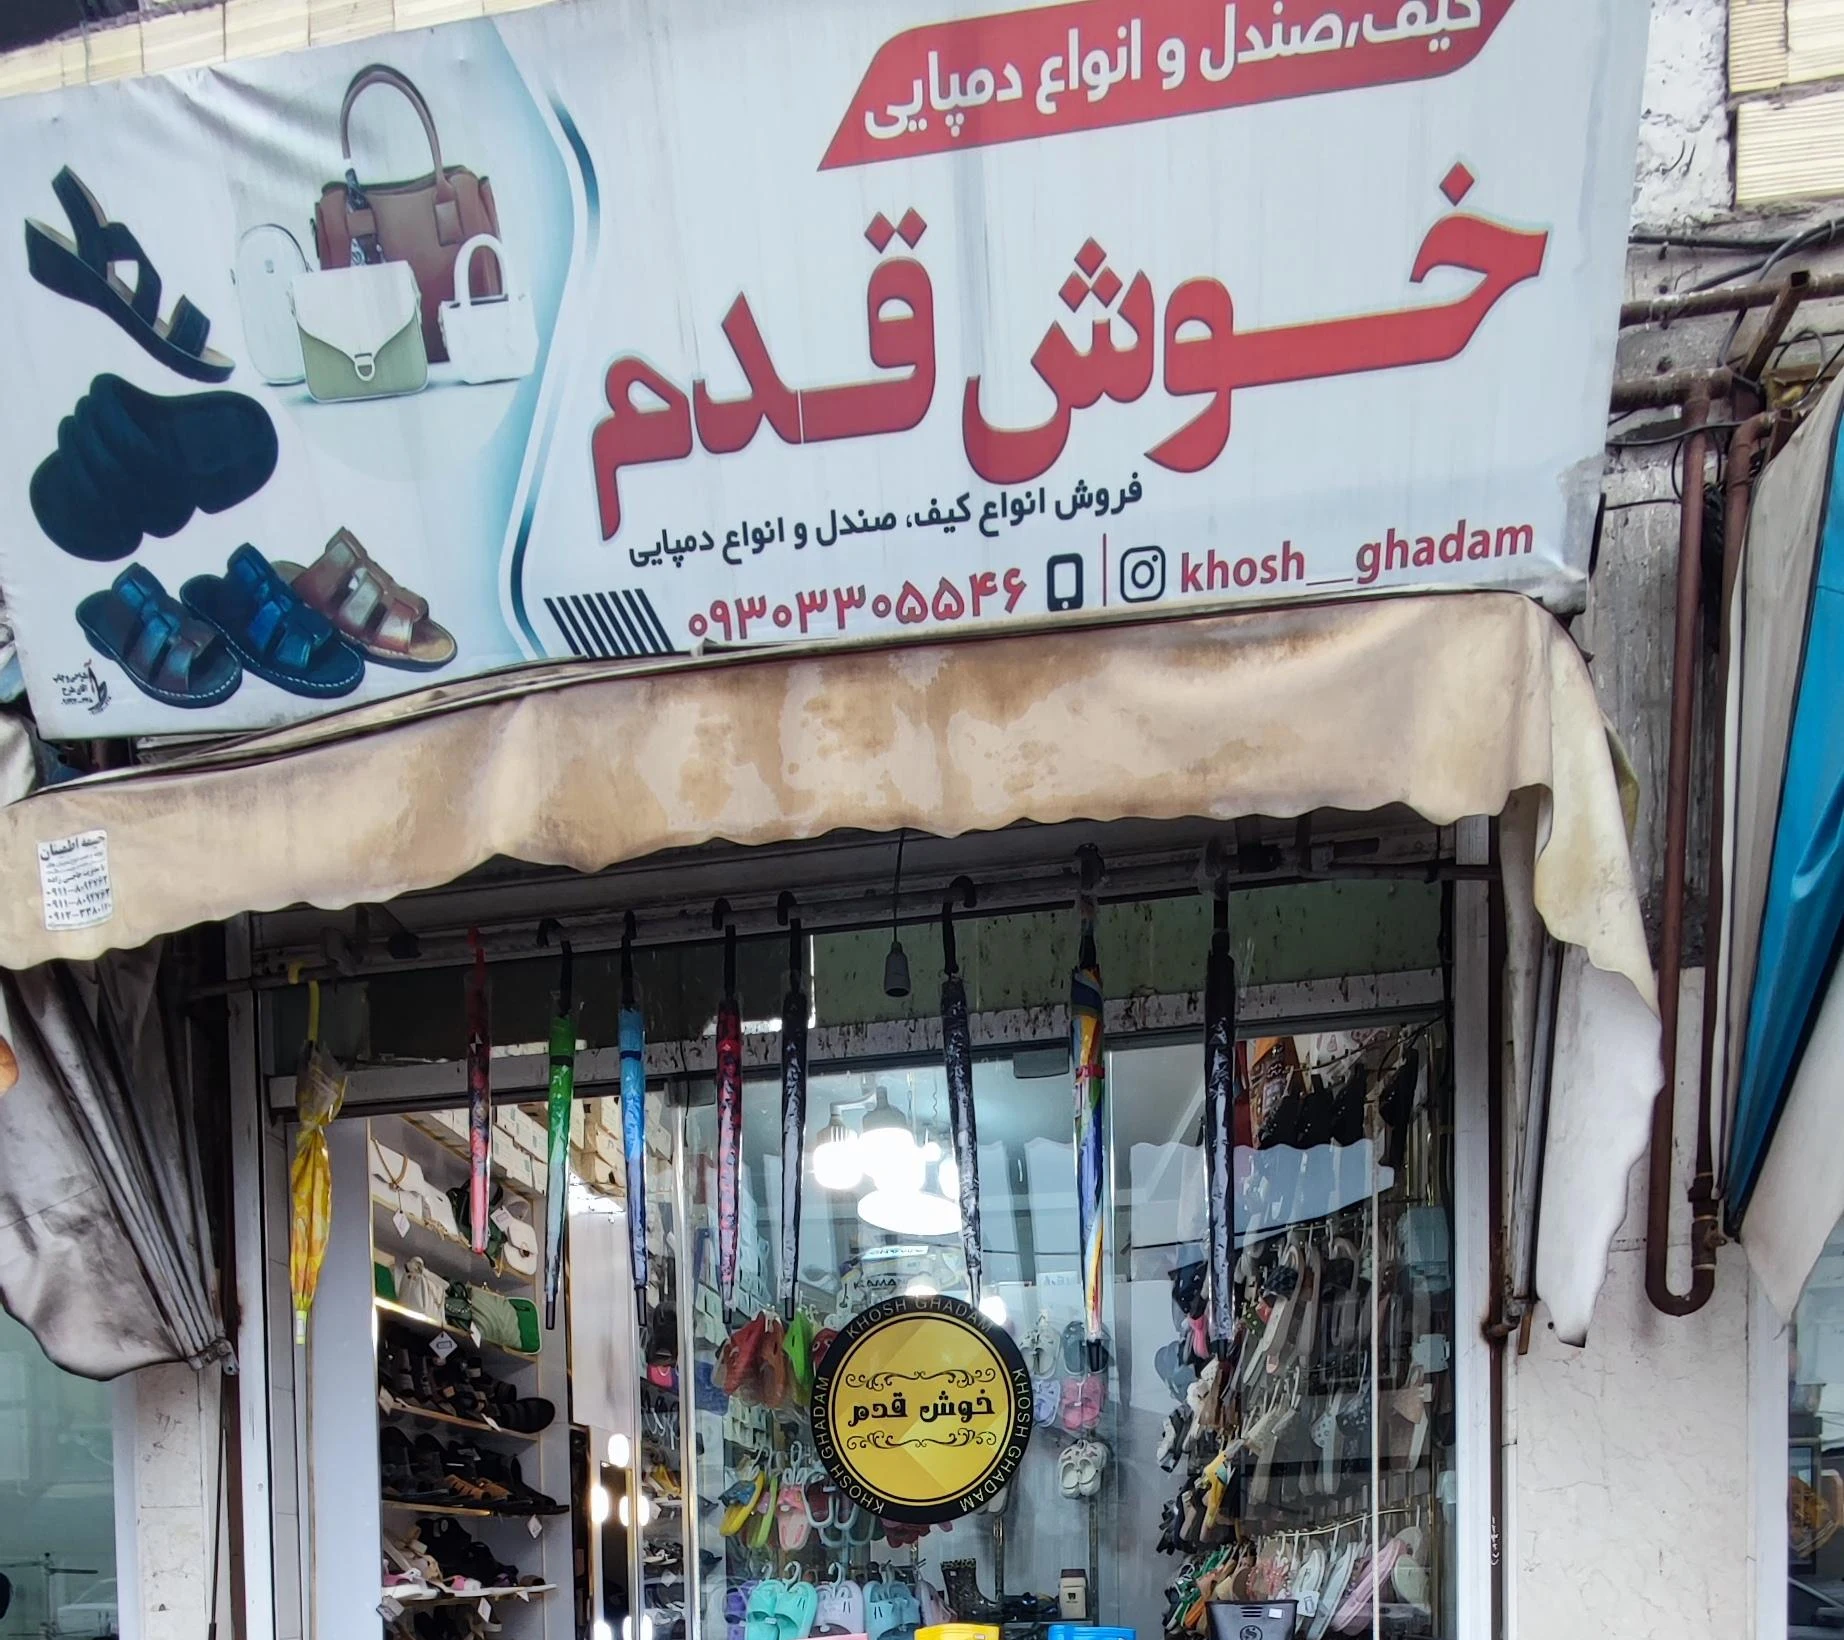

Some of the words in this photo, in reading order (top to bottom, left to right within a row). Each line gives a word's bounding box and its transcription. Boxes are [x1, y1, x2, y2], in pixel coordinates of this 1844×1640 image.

[1034, 19, 1142, 115] انواع
[1156, 35, 1186, 90] و
[864, 51, 1022, 139] دمپایی
[591, 206, 937, 542] قدم
[978, 487, 1046, 537] انواع
[1054, 472, 1144, 521] فروش
[629, 529, 715, 569] دمپایی
[721, 518, 784, 565] انواع
[794, 524, 806, 549] و
[815, 508, 898, 547] صندل
[687, 567, 1028, 641] ۰۹۳۰۳۳۰۵۵۴۶
[846, 1298, 907, 1341] KHOSH
[914, 1296, 993, 1335] GHADAM
[813, 1375, 834, 1460] GHADAM
[847, 1391, 908, 1427] قدم
[919, 1388, 996, 1423] خوش
[1012, 1367, 1033, 1439] KHOSH
[829, 1464, 885, 1515] KHOSH
[959, 1445, 1023, 1513] GHADAM
